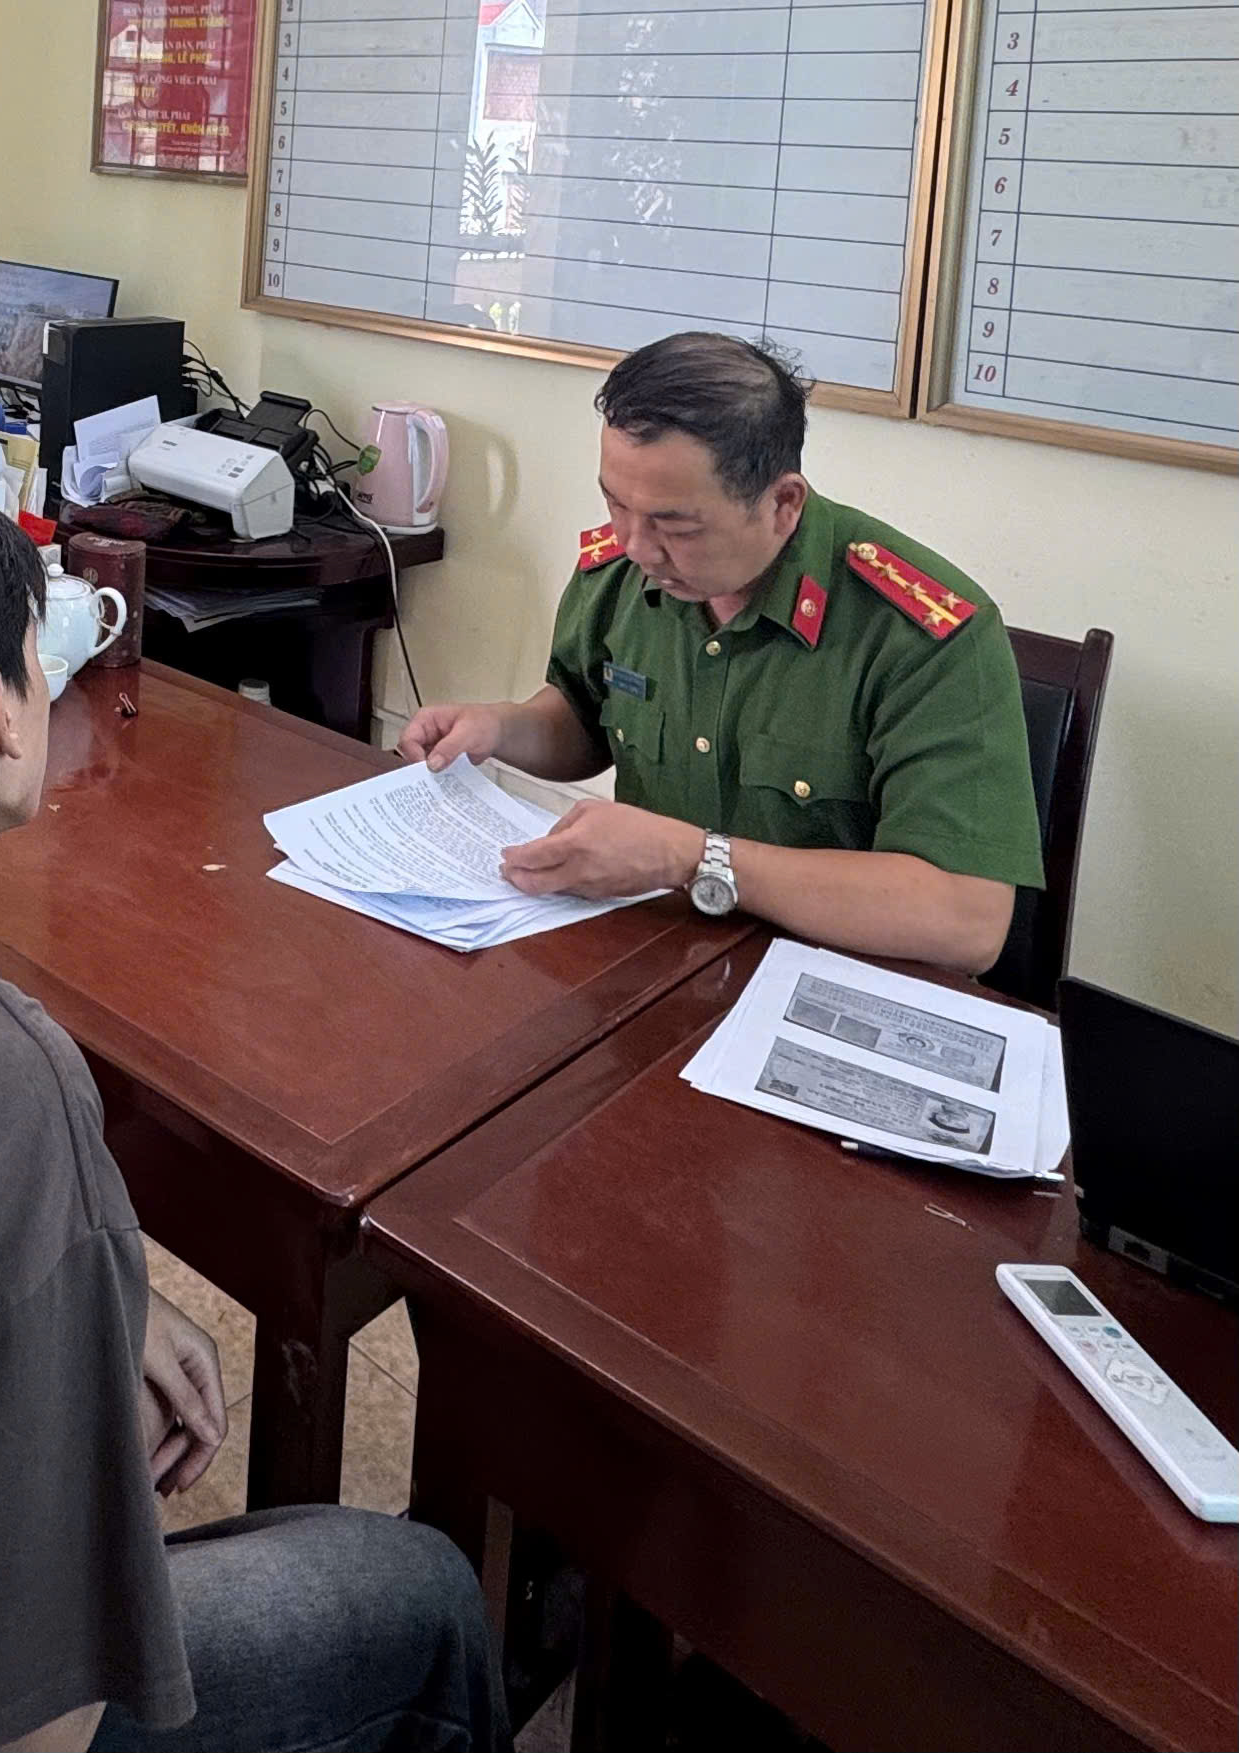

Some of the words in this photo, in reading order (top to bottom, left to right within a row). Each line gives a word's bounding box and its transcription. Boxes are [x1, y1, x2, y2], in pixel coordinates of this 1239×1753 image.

[284, 32, 292, 48] 3
[1006, 31, 1020, 51] 3
[281, 66, 290, 82] 4
[1004, 79, 1020, 97] 4
[279, 100, 288, 117] 5
[277, 135, 286, 150] 6
[997, 127, 1012, 146] 5
[276, 167, 284, 184] 7
[993, 176, 1009, 195] 6
[273, 202, 282, 218] 8
[272, 238, 280, 253] 9
[990, 228, 1003, 247] 7
[267, 272, 281, 288] 10
[986, 276, 1000, 296] 8
[981, 320, 995, 340] 9
[972, 363, 997, 383] 10
